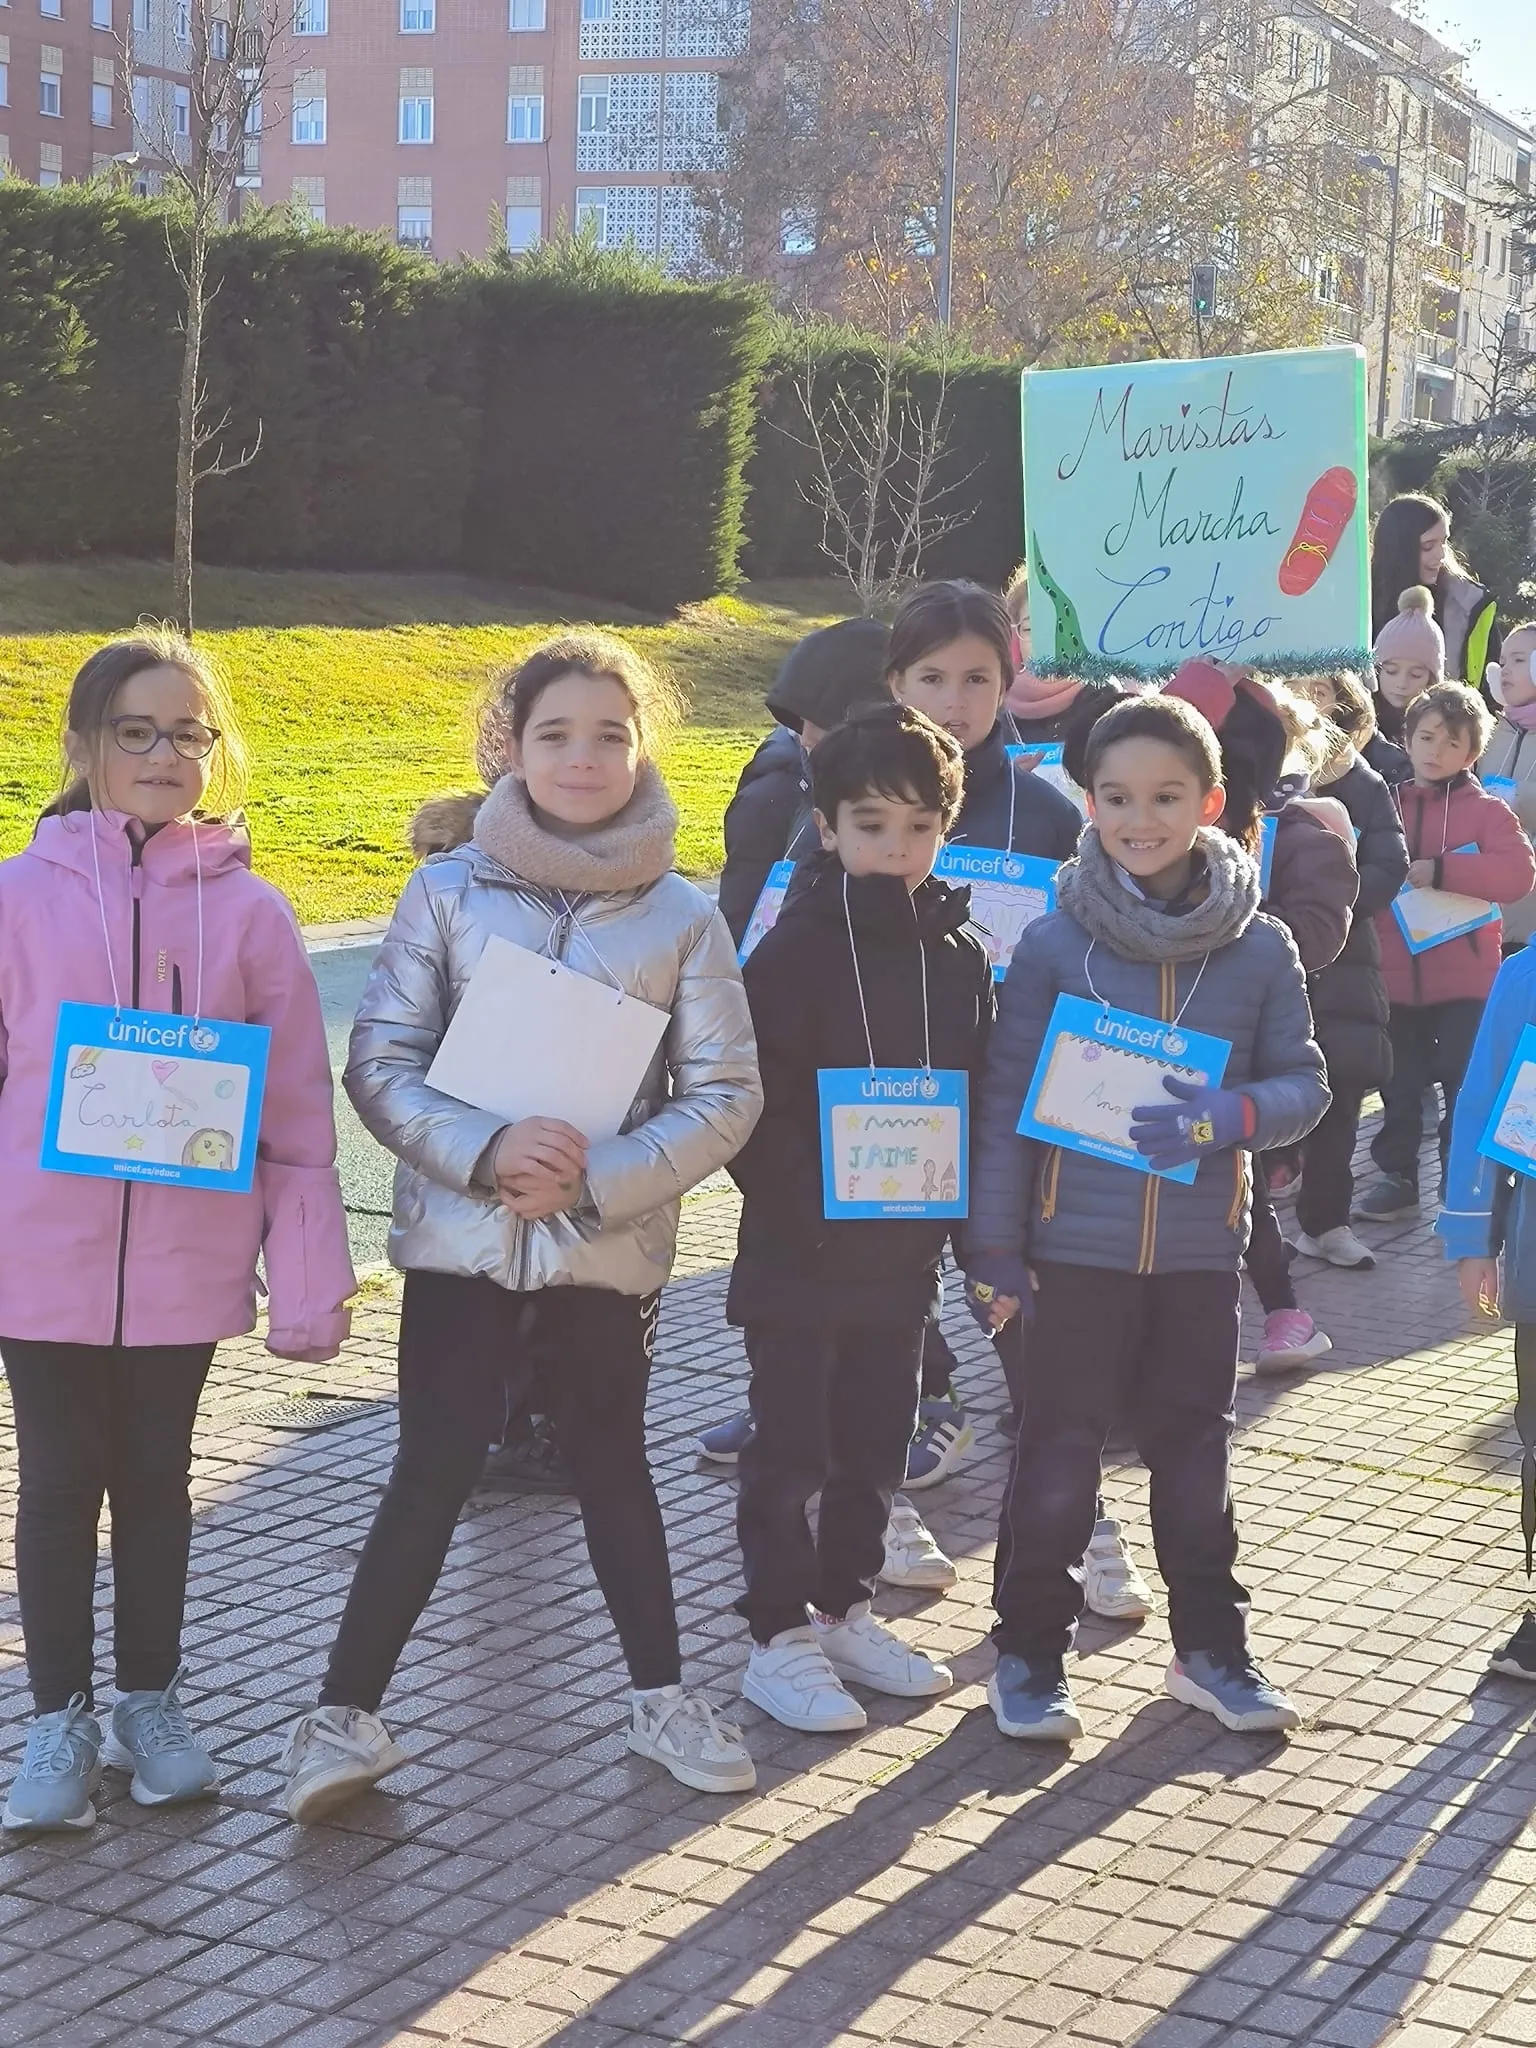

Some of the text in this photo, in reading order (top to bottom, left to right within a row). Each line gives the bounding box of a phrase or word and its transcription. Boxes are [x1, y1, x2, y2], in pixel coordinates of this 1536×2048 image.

[1058, 371, 1287, 480] Maristas
[1104, 467, 1280, 555] Marcha
[1095, 562, 1283, 661] Contigo
[940, 852, 1002, 875] unicef
[107, 1019, 189, 1048] unicef
[1094, 1017, 1164, 1049] unicef
[861, 1076, 920, 1098] unicef
[78, 1082, 196, 1128] Carlota
[848, 1143, 920, 1170] JAIME
